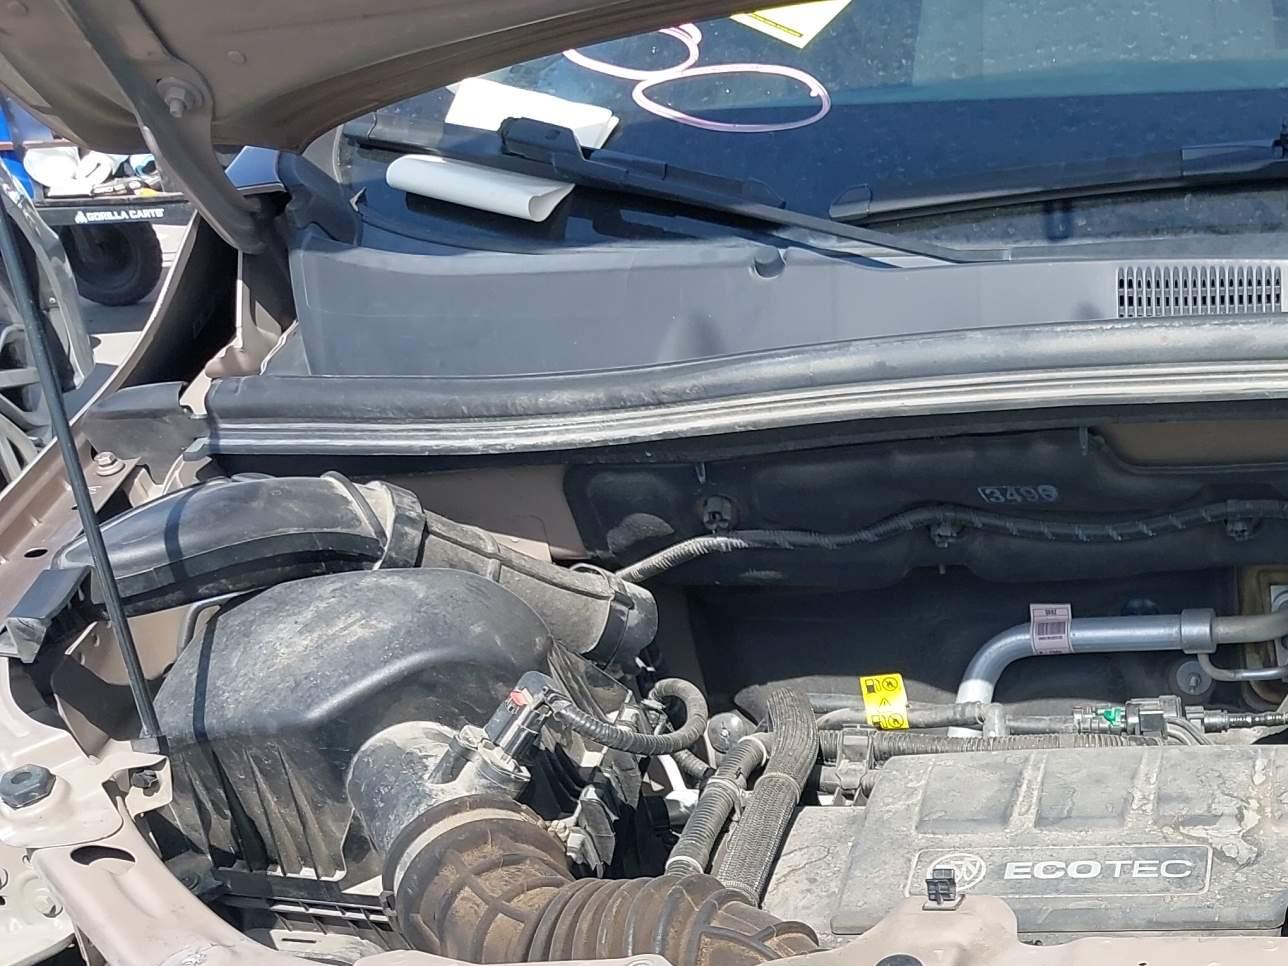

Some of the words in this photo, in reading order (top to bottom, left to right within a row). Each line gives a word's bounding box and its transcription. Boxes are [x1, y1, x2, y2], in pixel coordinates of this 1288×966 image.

[87, 210, 129, 222] GORILLA
[129, 208, 163, 219] CARTS
[1004, 860, 1193, 880] ECOTEC
